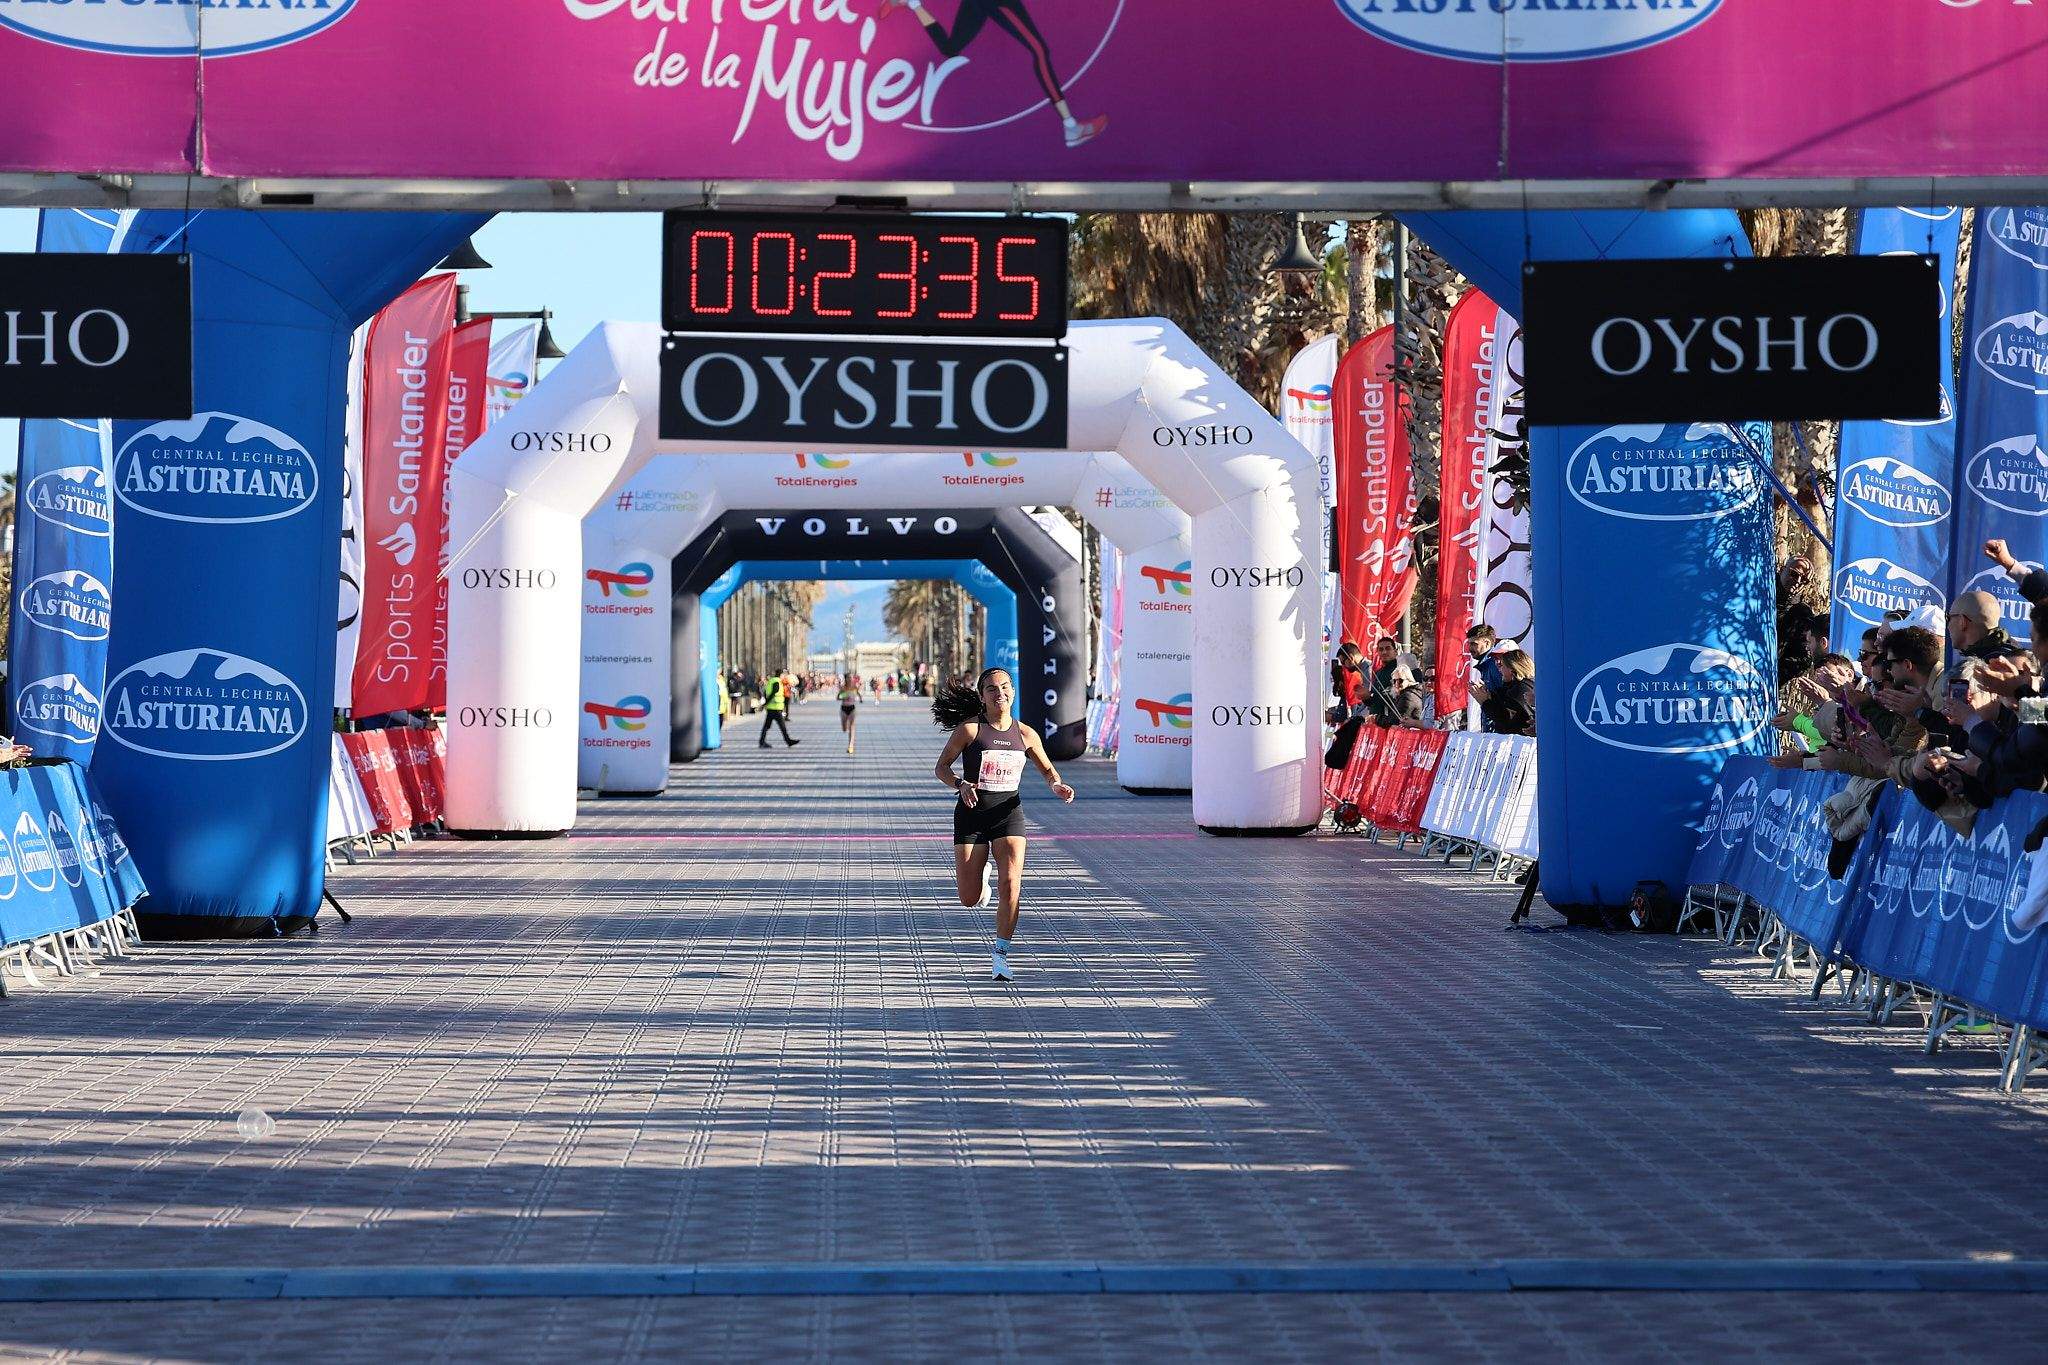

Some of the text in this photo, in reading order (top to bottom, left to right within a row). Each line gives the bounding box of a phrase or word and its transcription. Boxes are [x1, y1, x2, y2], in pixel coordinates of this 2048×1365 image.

[634, 17, 969, 162] de la Mujer
[1590, 313, 1880, 376] OYSHO
[680, 351, 1049, 434] OYSHO
[389, 331, 429, 516] Santander
[510, 431, 612, 453] OYSHO
[1153, 424, 1254, 447] OYSHO
[151, 449, 302, 467] CENTRAL LECHERA
[1358, 377, 1388, 534] Santander
[1612, 449, 1685, 461] CENTRAL
[122, 451, 307, 500] ASTURIANA
[774, 476, 858, 488] TotalEnergies
[942, 474, 1025, 487] TotalEnergies
[1846, 472, 1942, 516] ASTURIANA
[1895, 482, 1938, 497] LECHERA
[35, 483, 108, 521] ASTURIA
[755, 516, 959, 536] VOLVO
[463, 567, 556, 589] OYSHO
[1210, 566, 1304, 588] OYSHO
[1855, 575, 1932, 597] CENTRAL LECHERA
[585, 604, 654, 615] TotalEnergies
[377, 573, 418, 683] Sports
[584, 655, 653, 664] totalenergies.es
[1043, 596, 1059, 739] VOLVO
[141, 685, 291, 702] CENTRAL LECHERA
[1617, 682, 1691, 693] CENTRAL
[111, 687, 295, 735] ASTURIANA
[1585, 684, 1765, 725] ASTURIANA
[459, 706, 552, 729] OYSHO
[1211, 705, 1305, 728] OYSHO
[583, 737, 651, 749] TotalEnergies
[1134, 734, 1192, 747] TotalEnergi
